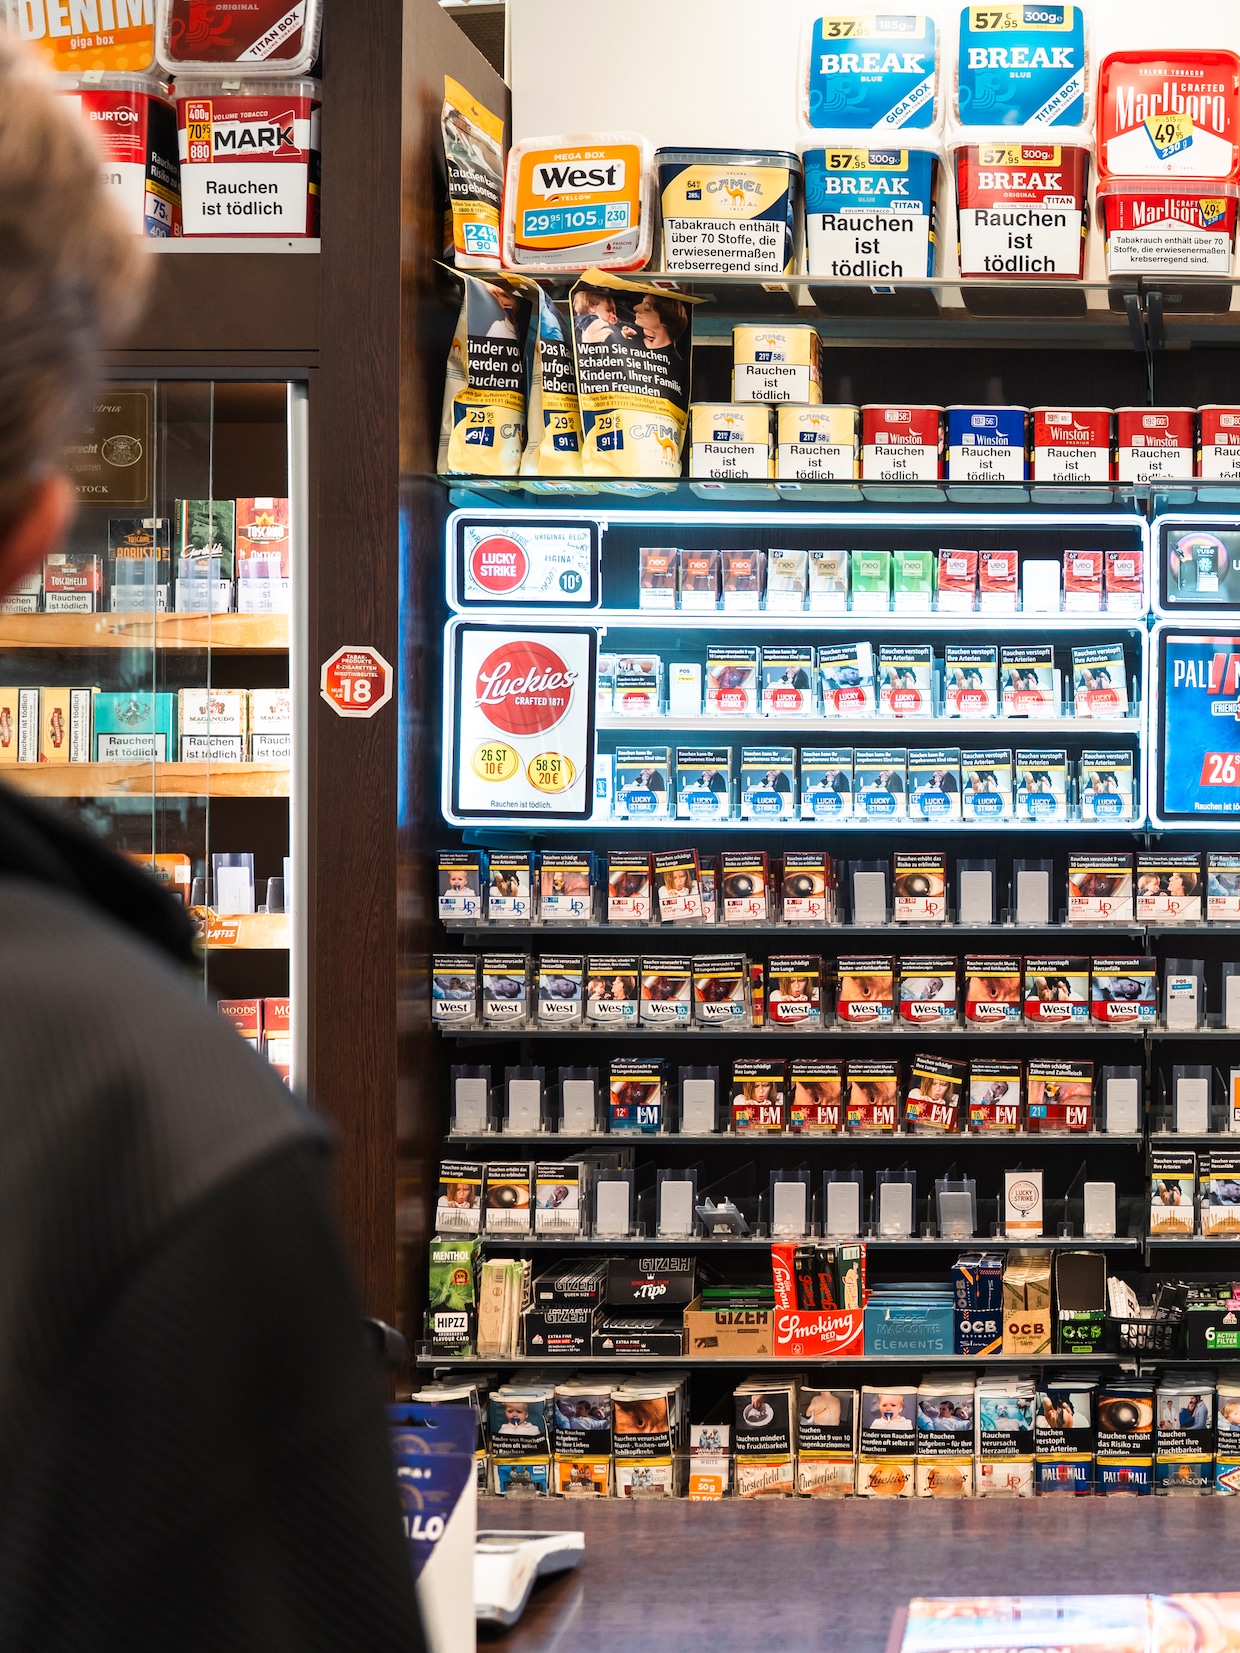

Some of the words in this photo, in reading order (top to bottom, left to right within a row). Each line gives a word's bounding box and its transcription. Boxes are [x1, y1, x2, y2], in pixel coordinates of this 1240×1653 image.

[70, 36, 89, 51] giga
[92, 34, 114, 46] box
[820, 53, 925, 74] BREAK
[968, 48, 1074, 69] BREAK
[1181, 83, 1224, 92] CRAFTED
[90, 111, 138, 123] BURTON
[554, 152, 581, 161] MEGA
[583, 151, 605, 159] BOX
[540, 165, 617, 188] West
[978, 172, 1062, 190] BREAK
[206, 180, 278, 195] Rauchen
[825, 178, 909, 194] BREAK
[202, 202, 221, 216] ist
[226, 200, 282, 216] tödlich
[668, 220, 743, 231] Tabakrauch
[747, 221, 780, 232] enthält
[822, 215, 913, 231] Rauchen
[672, 233, 696, 244] über
[702, 232, 714, 243] 70
[718, 234, 754, 246] Stoffe,
[758, 236, 776, 245] die
[856, 238, 880, 254] ist
[672, 246, 776, 259] erwiesenermaßen
[667, 259, 750, 272] krebserregend
[754, 262, 782, 272] sind.
[832, 261, 902, 277] tödlich
[578, 344, 609, 356] Wenn
[611, 344, 628, 354] Sie
[630, 348, 670, 365] rauchen,
[579, 357, 624, 368] schaden
[626, 358, 640, 369] Sie
[642, 360, 668, 374] Ihren
[746, 366, 796, 376] Rauchen
[580, 370, 626, 382] Kindern,
[628, 372, 652, 385] Ihrer
[764, 379, 777, 387] ist
[580, 384, 610, 394] Ihren
[612, 384, 660, 397] Freunden
[751, 390, 790, 400] tödlich
[890, 433, 922, 444] Winston
[1050, 427, 1089, 441] Winston
[75, 485, 108, 493] STOCK
[247, 525, 284, 538] TOSCANO
[482, 553, 516, 564] LUCKY
[480, 565, 517, 576] STRIKE
[1174, 660, 1216, 688] PALL
[339, 680, 371, 702] 18
[474, 662, 578, 708] Luckies
[515, 697, 547, 705] CRAFTED
[549, 697, 564, 706] 1871
[1215, 703, 1240, 712] FRIENDS
[109, 736, 154, 746] Rauchen
[105, 748, 120, 757] ist
[122, 747, 157, 757] tödlich
[482, 750, 492, 760] 26
[496, 751, 506, 760] ST
[485, 763, 495, 774] 10
[536, 761, 547, 771] 58
[551, 760, 561, 771] ST
[1209, 756, 1234, 782] 26
[539, 773, 550, 784] 20
[529, 801, 552, 809] tödlich.
[1195, 802, 1222, 810] Rauchen
[1223, 802, 1231, 810] ist
[207, 929, 236, 939] KAFFEE
[221, 1006, 256, 1014] MOODS
[439, 1002, 468, 1012] West
[849, 1004, 879, 1014] West
[432, 1251, 469, 1260] MENTHOL
[639, 1258, 691, 1272] GIZEH
[437, 1316, 465, 1328] HIPZZ
[960, 1321, 997, 1334] OCB
[778, 1314, 852, 1344] Smoking
[876, 1324, 940, 1334] MASCOTTE
[1009, 1324, 1044, 1334] OCB
[874, 1339, 943, 1350] ELEMENTS
[1217, 1338, 1238, 1346] FILTER
